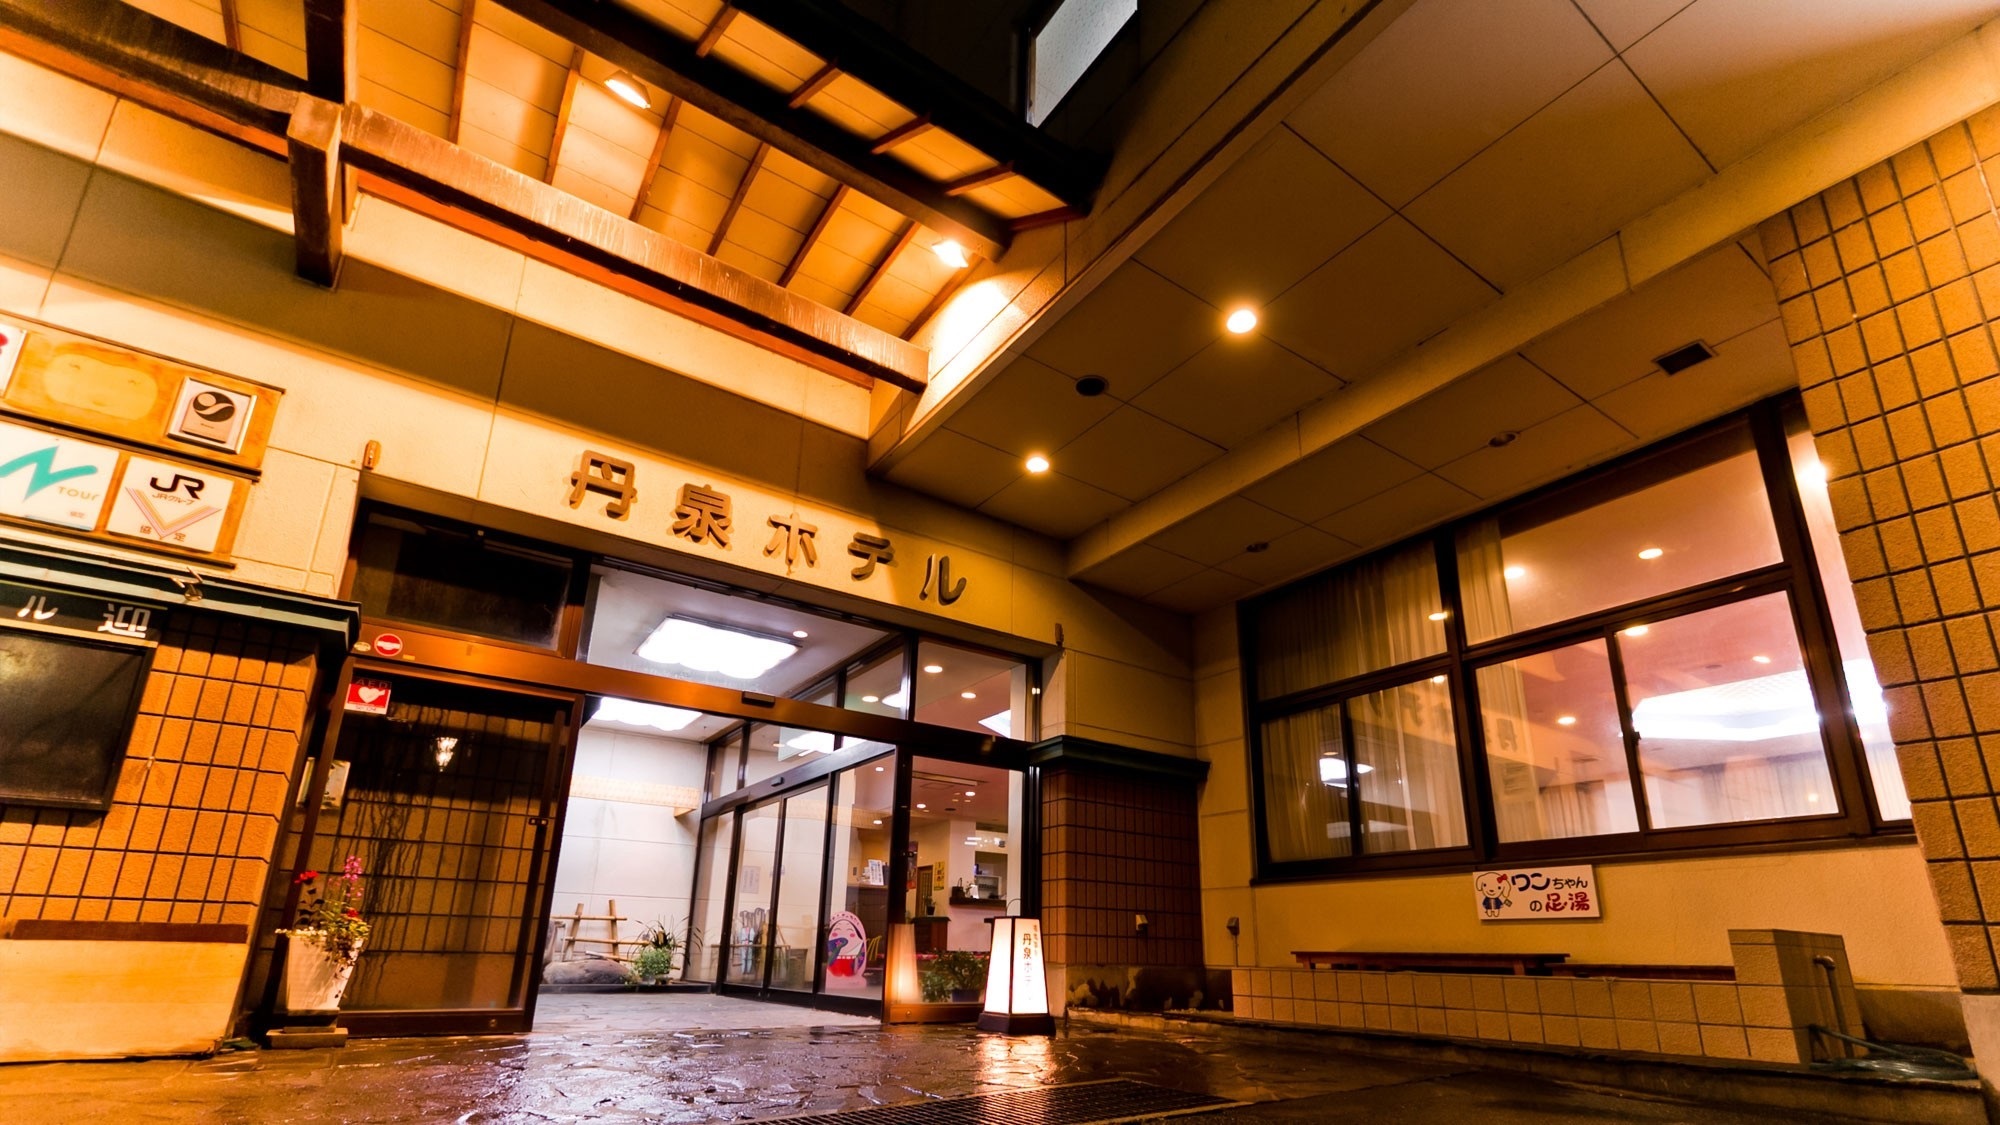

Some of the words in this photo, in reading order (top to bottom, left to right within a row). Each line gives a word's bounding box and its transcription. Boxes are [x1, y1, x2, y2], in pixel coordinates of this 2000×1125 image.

[149, 474, 205, 500] JR
[569, 449, 968, 606] 丹泉ホテル
[97, 603, 151, 639] 迎
[1511, 872, 1588, 891] ワンちゃん
[1529, 891, 1590, 912] の足湯
